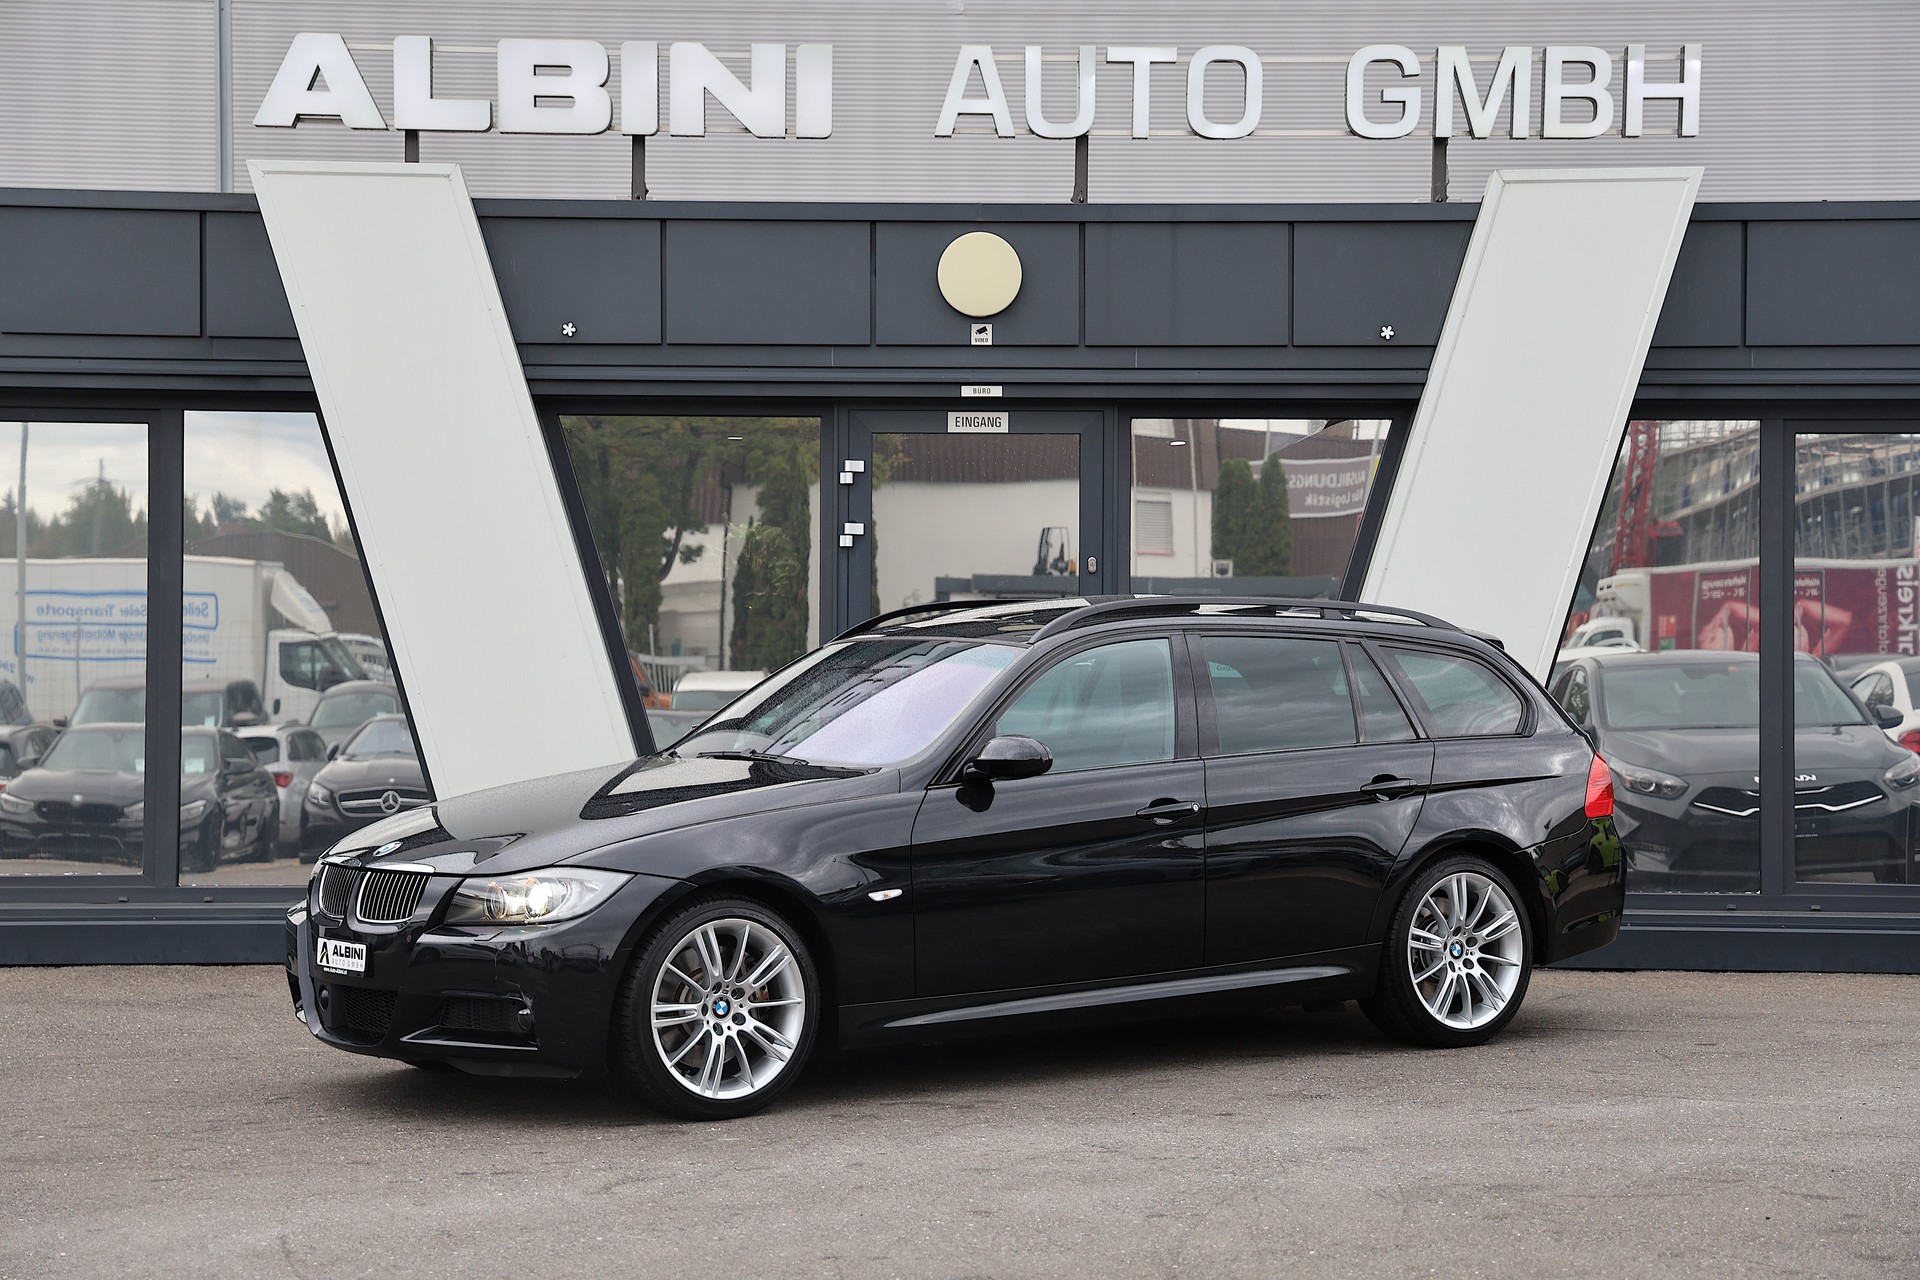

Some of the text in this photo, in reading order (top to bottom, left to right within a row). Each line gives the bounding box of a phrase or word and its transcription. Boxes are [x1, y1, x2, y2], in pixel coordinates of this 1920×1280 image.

[253, 32, 1703, 140] ALBINI AUTO GMBH
[972, 387, 991, 395] BÜRO
[955, 416, 1002, 428] EINGANG
[332, 944, 364, 960] ALBINI
